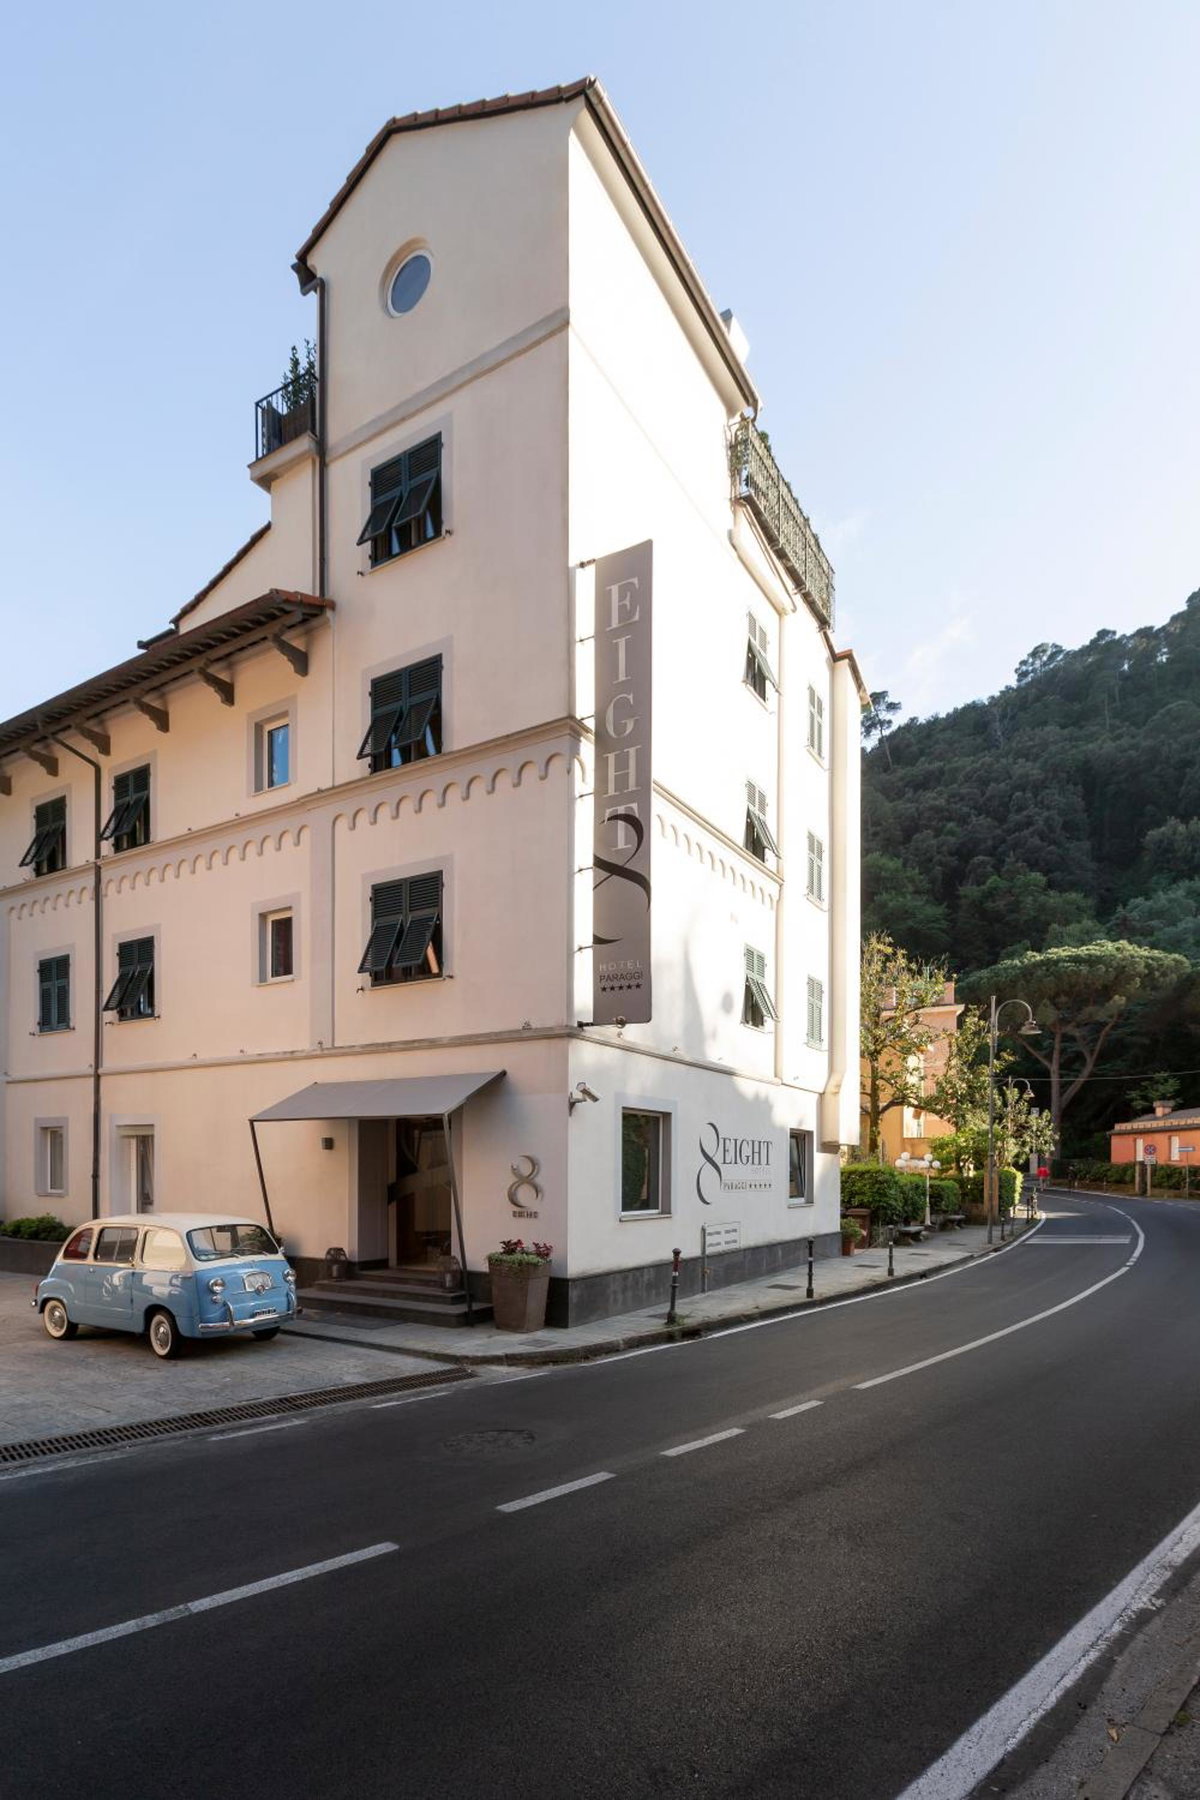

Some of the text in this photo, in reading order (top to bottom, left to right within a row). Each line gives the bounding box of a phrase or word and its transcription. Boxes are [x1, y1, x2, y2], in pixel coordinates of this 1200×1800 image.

[602, 576, 642, 852] EIGHT
[599, 960, 642, 971] HOTEL
[599, 971, 643, 983] PARAGGI
[696, 1122, 722, 1206] 8
[721, 1137, 773, 1166] EIGHT
[507, 1154, 540, 1208] 8
